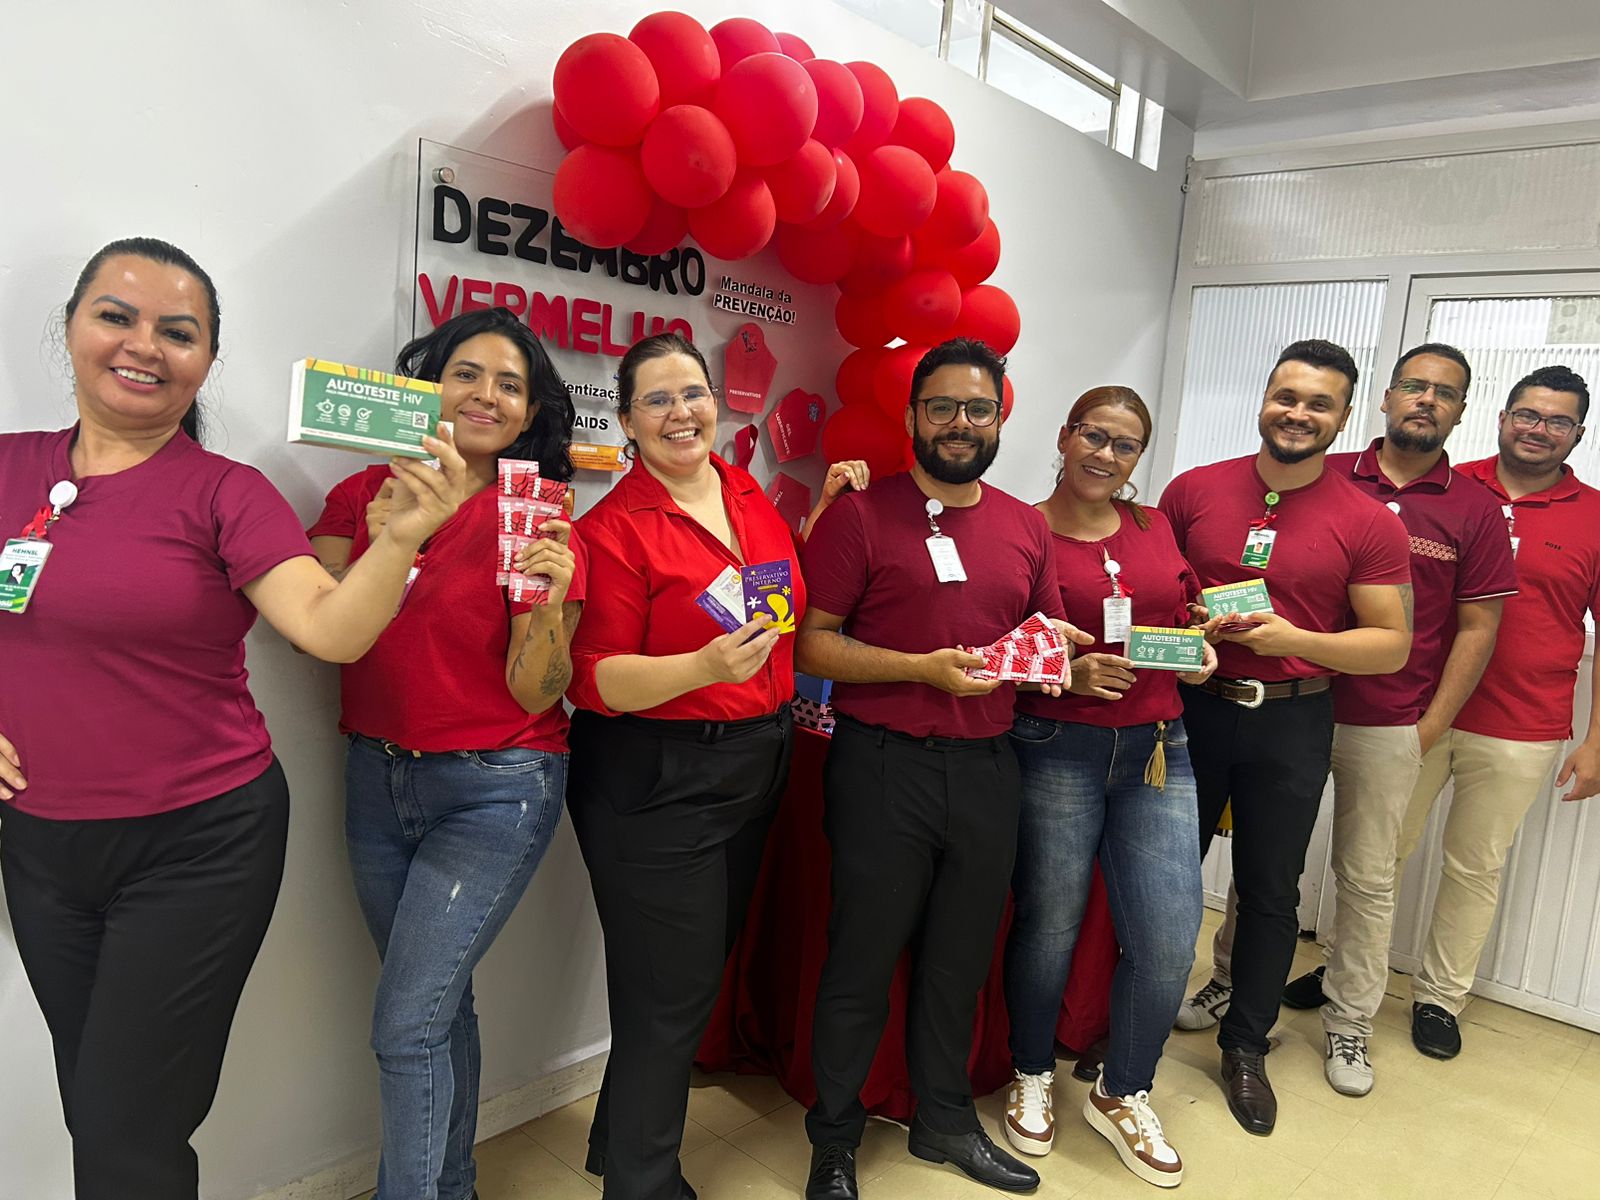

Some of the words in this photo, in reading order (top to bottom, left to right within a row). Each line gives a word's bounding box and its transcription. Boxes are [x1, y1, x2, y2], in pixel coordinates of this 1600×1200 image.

[433, 185, 705, 296] DEZEMBRO
[721, 276, 774, 300] Mandala
[778, 290, 792, 304] da
[714, 294, 796, 323] PREVENÇÃO!
[326, 378, 400, 401] AUTOTESTE
[403, 392, 423, 406] HIV
[574, 415, 609, 430] AIDS
[745, 571, 789, 583] PRESERVATIVO
[752, 577, 782, 586] INTERNO
[1213, 588, 1248, 599] AUTOTESTE
[1142, 634, 1181, 643] AUTOTESTE
